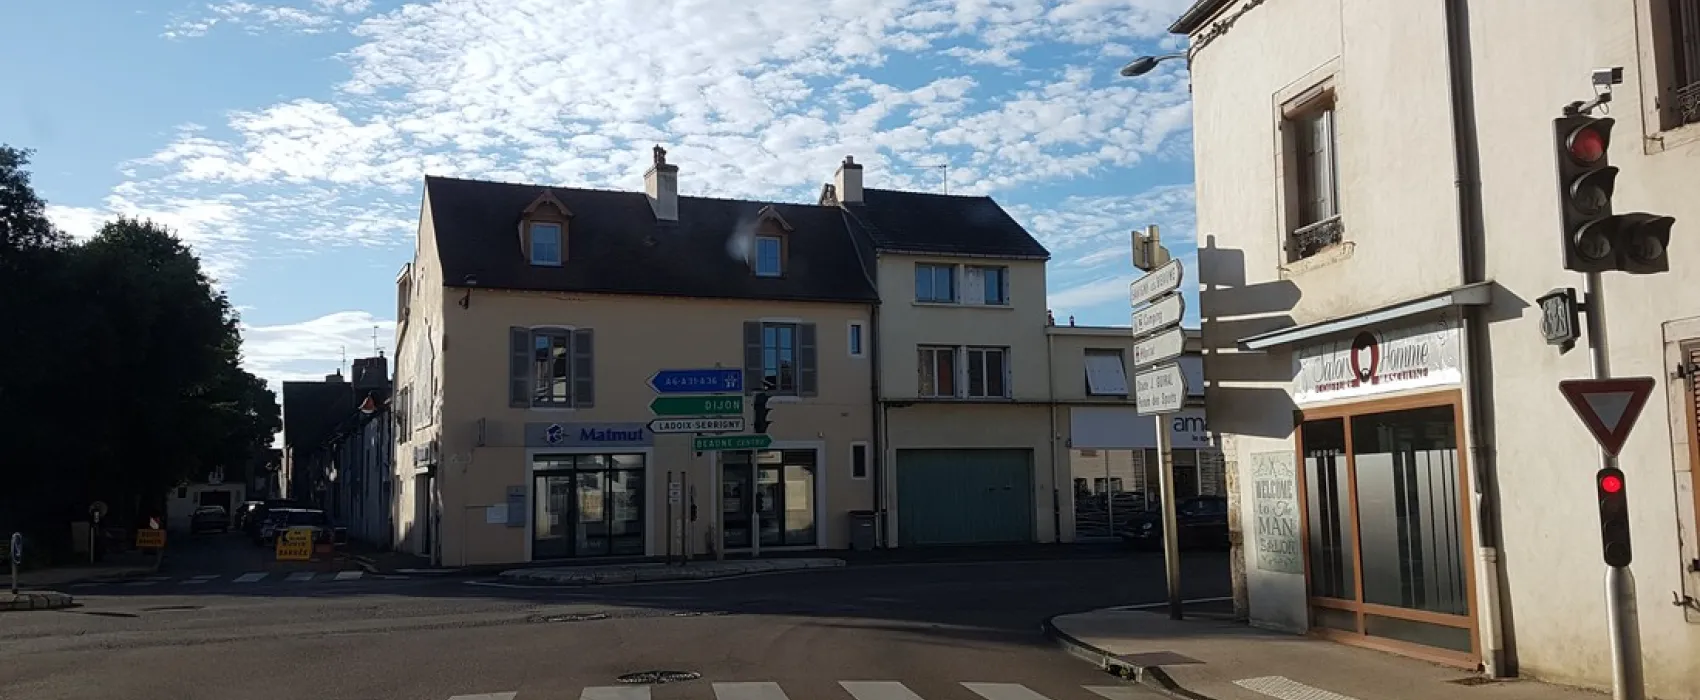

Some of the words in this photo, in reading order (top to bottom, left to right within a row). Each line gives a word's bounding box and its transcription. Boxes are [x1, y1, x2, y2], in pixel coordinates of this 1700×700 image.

[1379, 341, 1429, 374] Homme
[703, 400, 740, 411] DIJON
[579, 428, 643, 441] Matmut
[695, 439, 732, 449] BEAUNE
[1256, 480, 1293, 499] WELCOME
[1258, 503, 1270, 515] to
[1258, 516, 1294, 537] MAN
[1260, 538, 1297, 555] SALON
